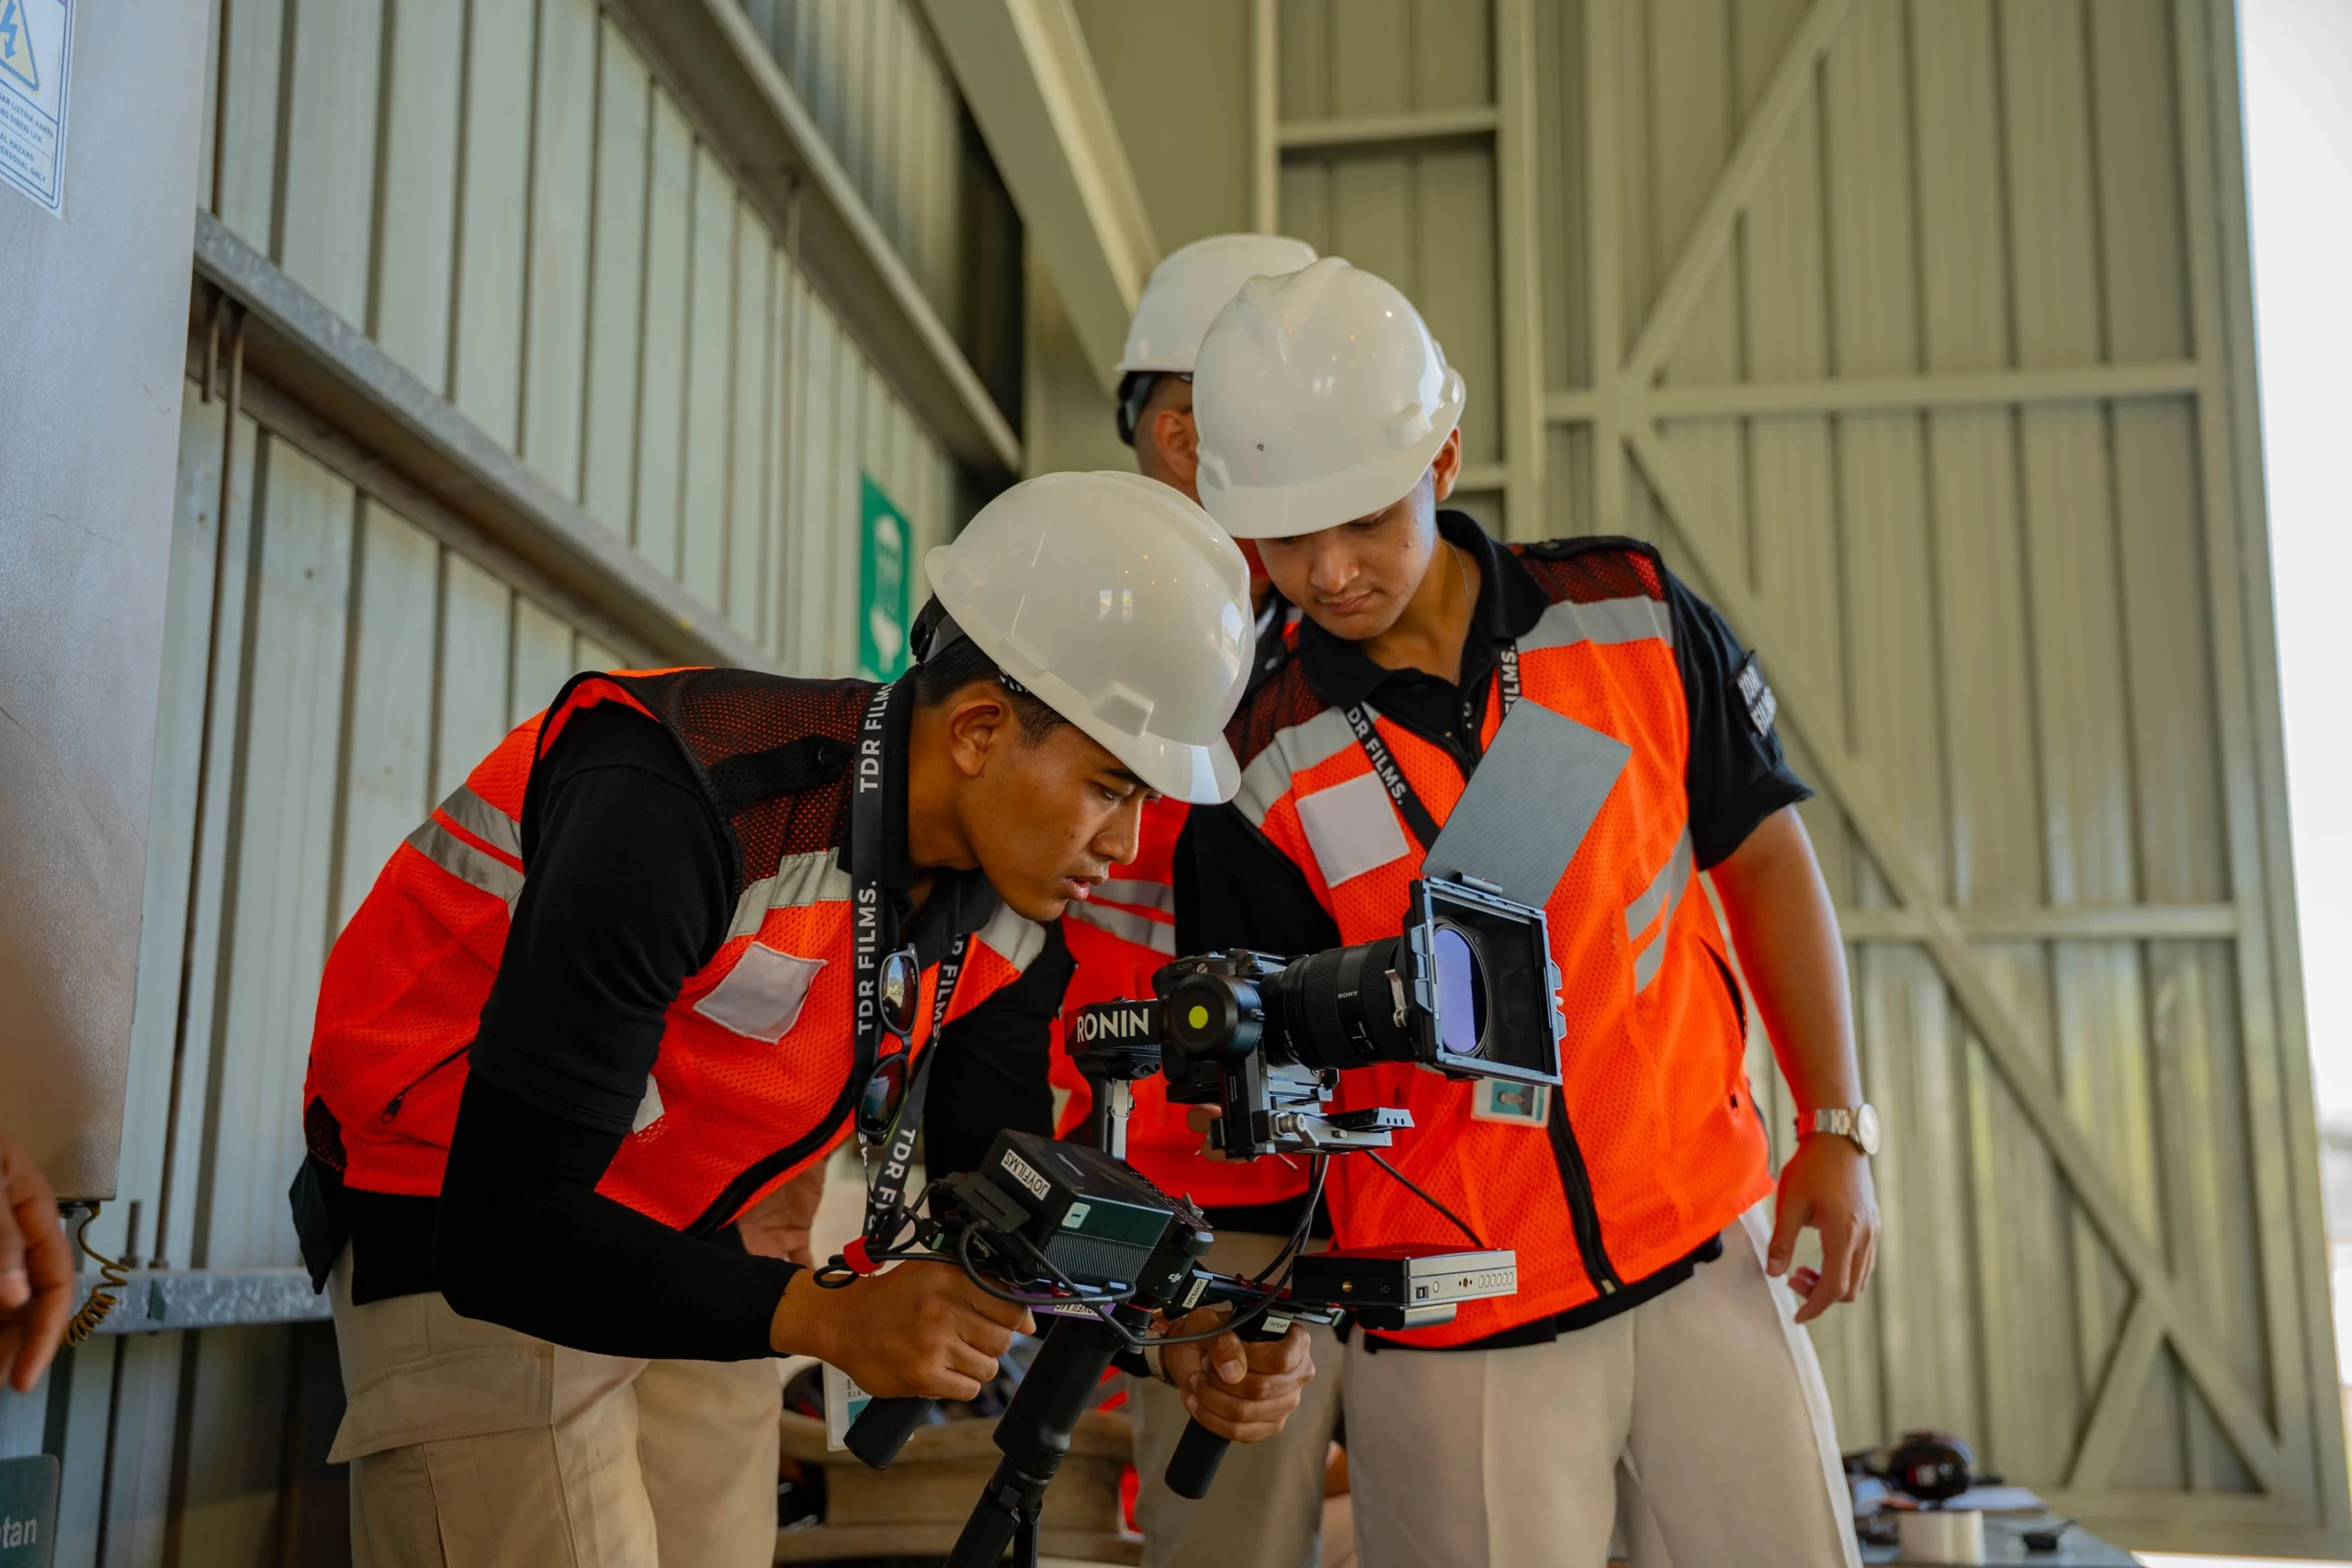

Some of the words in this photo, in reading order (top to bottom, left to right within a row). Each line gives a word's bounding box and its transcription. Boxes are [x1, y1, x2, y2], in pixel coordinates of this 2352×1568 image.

[859, 739, 881, 794] TDR
[1347, 705, 1370, 739] DR
[1364, 738, 1408, 806] FILMS.
[858, 880, 877, 969] FILMS.
[858, 979, 874, 1036] TDR
[1337, 990, 1359, 999] SONY
[1077, 1008, 1149, 1043] RONIN
[884, 1129, 916, 1179] TDR
[1003, 1152, 1048, 1195] JOYFILMS
[0, 1515, 37, 1550] tan
